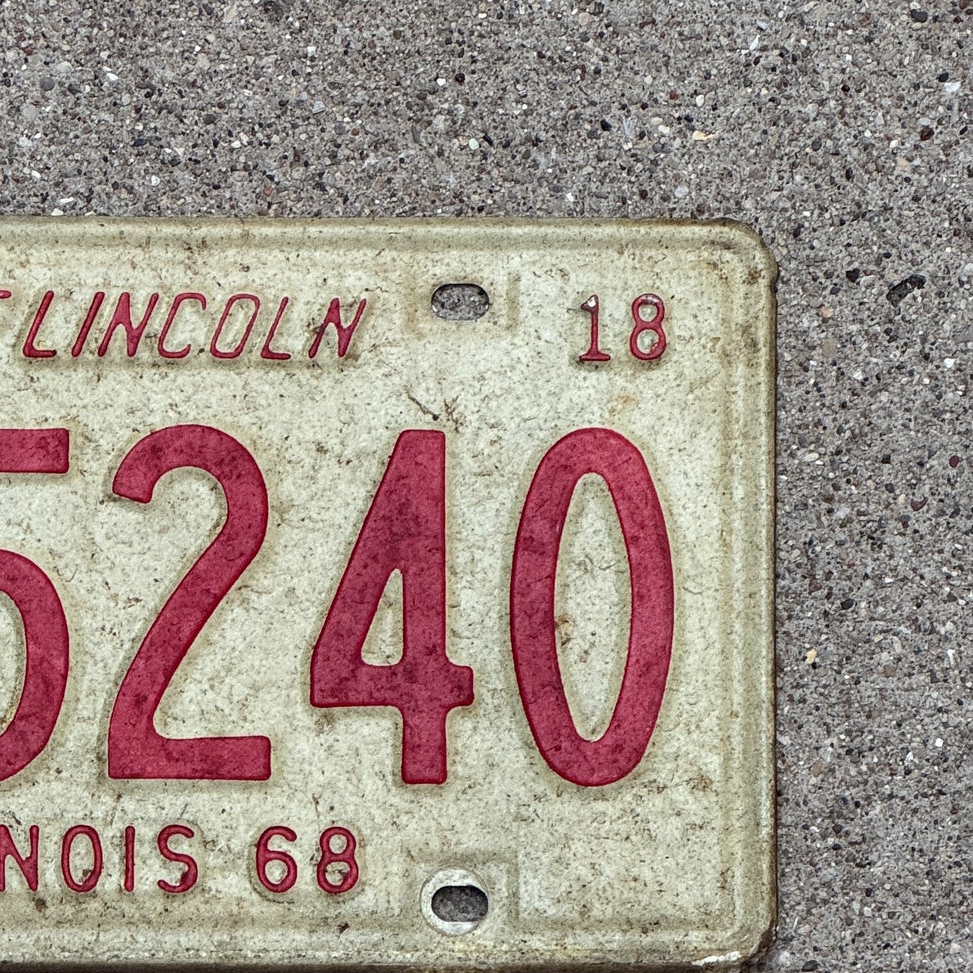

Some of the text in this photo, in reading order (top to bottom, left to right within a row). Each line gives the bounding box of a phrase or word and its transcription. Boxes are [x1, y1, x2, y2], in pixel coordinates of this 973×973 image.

[23, 289, 368, 361] LINCOLN
[580, 294, 669, 364] 18
[256, 825, 360, 895] 68
